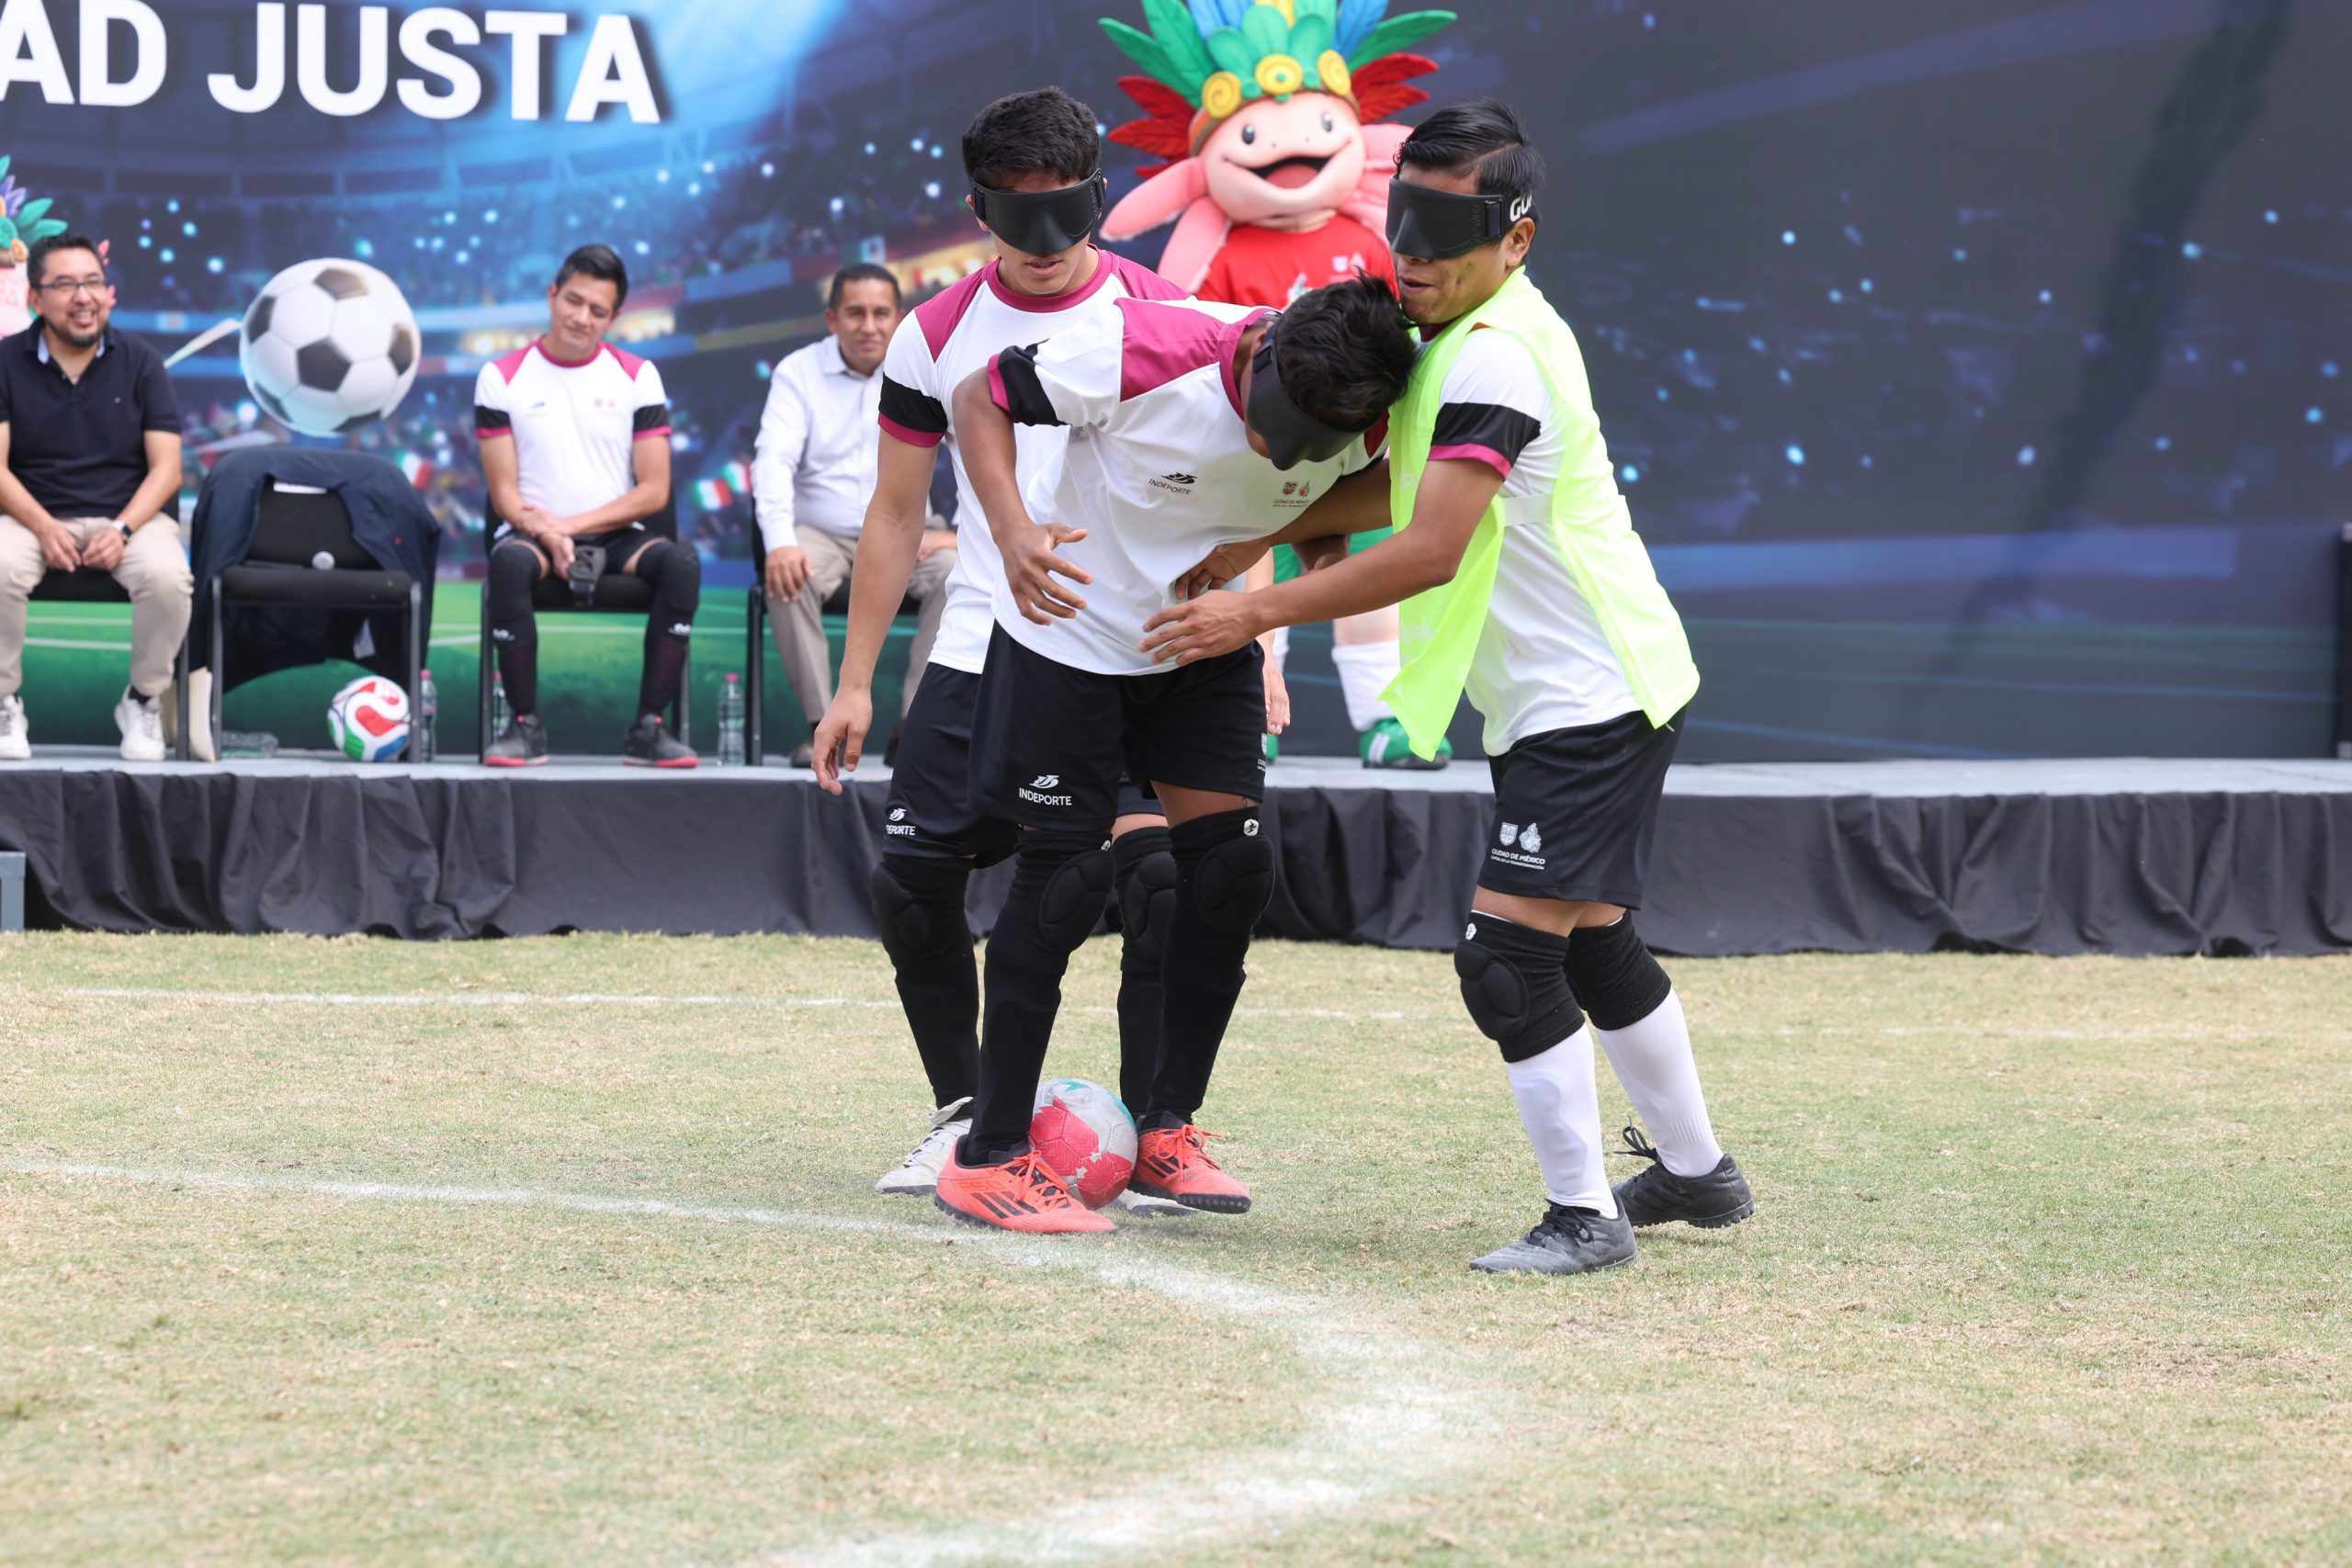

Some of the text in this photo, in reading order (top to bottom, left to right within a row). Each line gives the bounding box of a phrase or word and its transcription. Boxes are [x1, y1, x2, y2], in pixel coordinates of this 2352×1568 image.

[208, 2, 660, 124] JUSTA
[1148, 478, 1192, 495] INDEPORTE
[1019, 787, 1072, 806] INDEPORTE
[1491, 848, 1546, 865] CIUDAD DE MÉXICO
